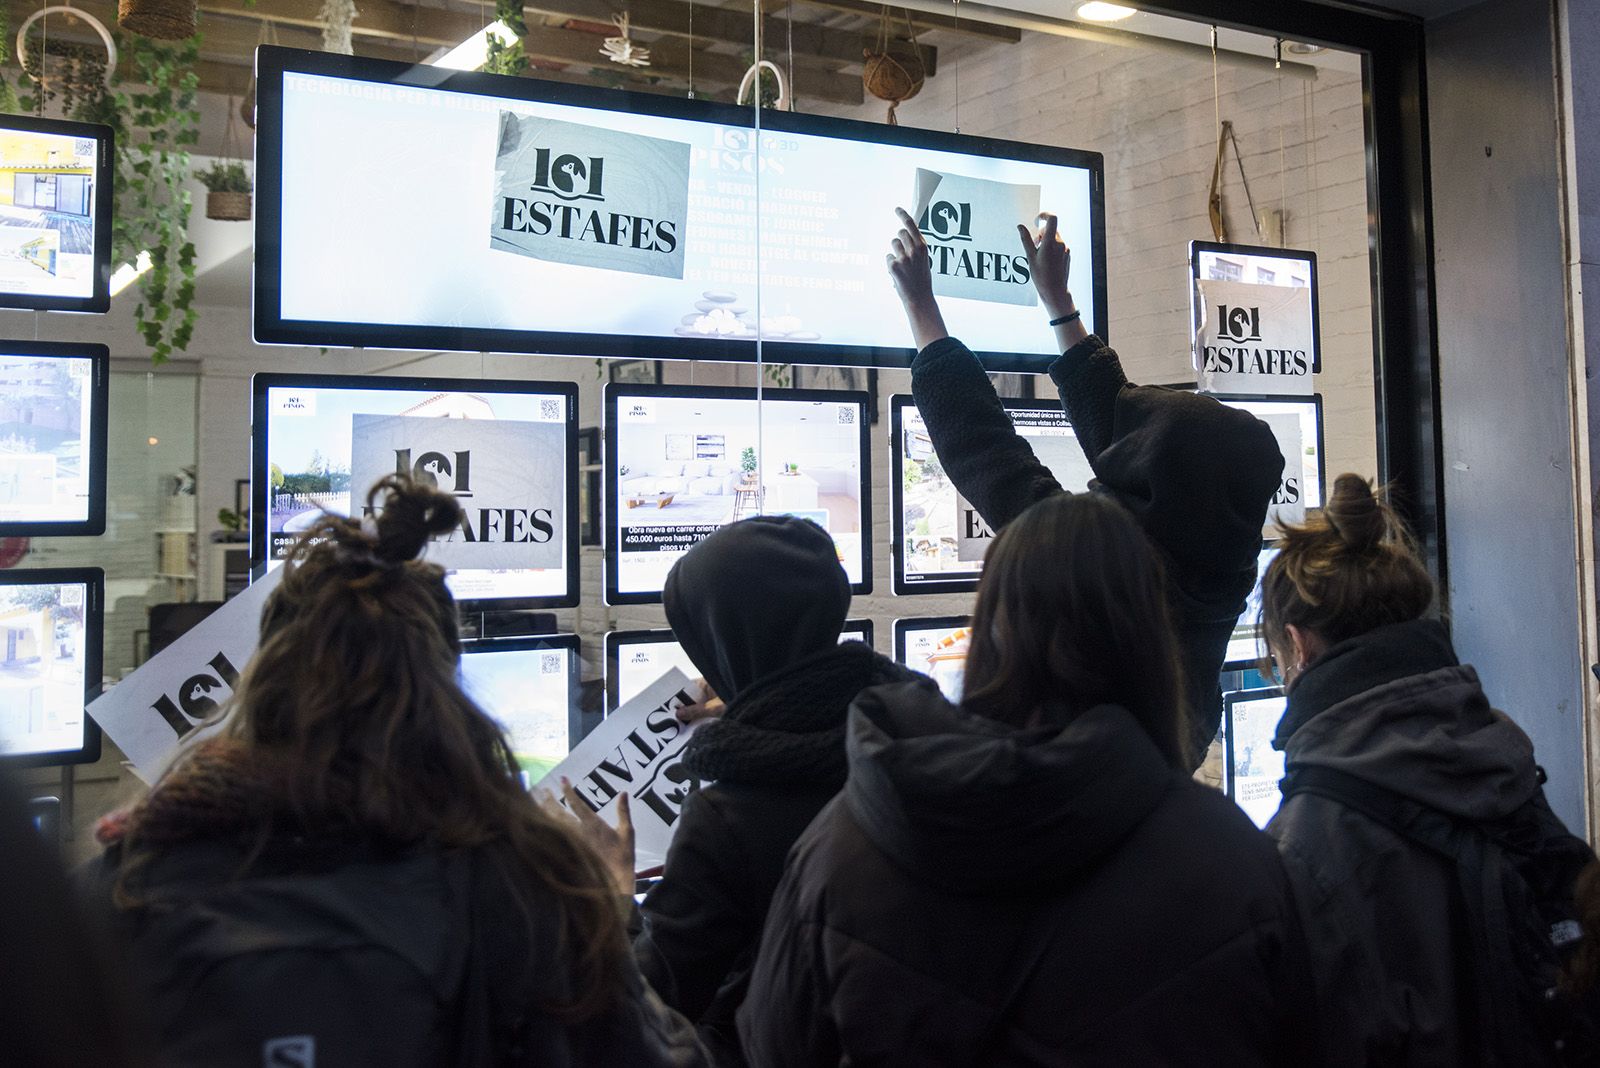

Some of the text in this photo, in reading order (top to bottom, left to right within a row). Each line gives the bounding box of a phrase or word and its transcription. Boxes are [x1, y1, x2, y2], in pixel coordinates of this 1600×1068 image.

[532, 148, 605, 199] 101
[501, 197, 677, 254] ESTAFES
[927, 244, 1031, 285] TAFES
[1217, 304, 1261, 339] 101
[1203, 346, 1308, 376] ESTAFES
[274, 537, 295, 546] casa
[625, 535, 653, 544] 450.000
[674, 534, 693, 542] hasta
[628, 526, 645, 534] Obra
[646, 526, 666, 534] nueva
[660, 543, 678, 552] pisos
[149, 651, 241, 739] 101
[559, 687, 697, 813] ESTAFE
